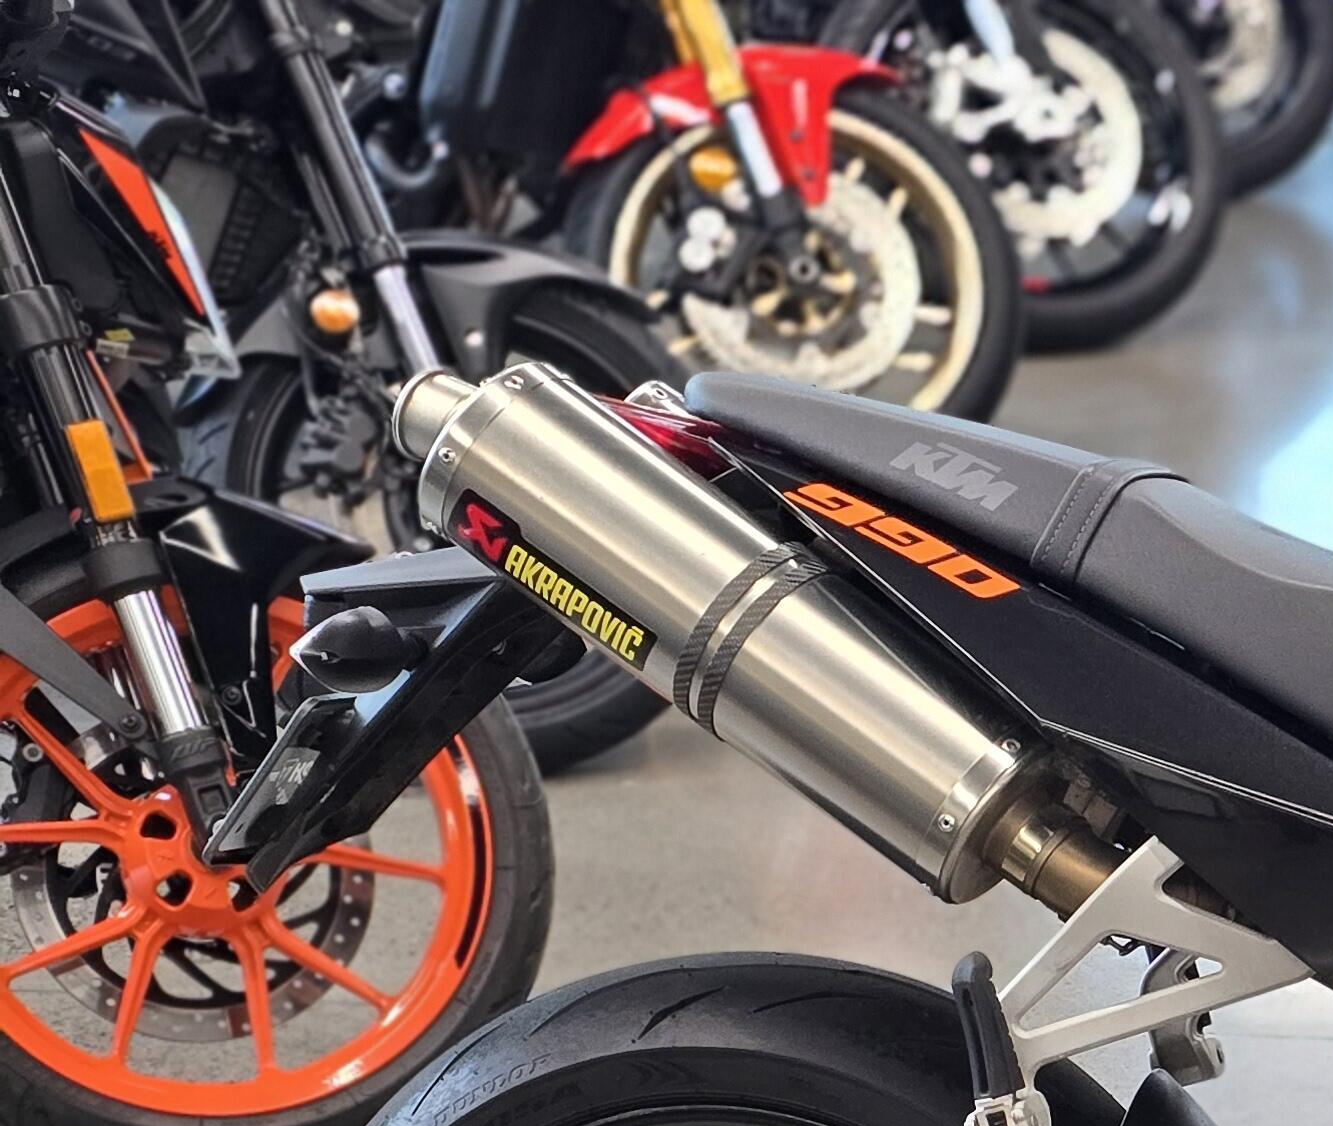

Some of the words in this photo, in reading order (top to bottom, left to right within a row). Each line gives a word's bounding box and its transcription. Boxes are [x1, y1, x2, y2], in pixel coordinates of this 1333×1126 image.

[889, 442, 1018, 511] KTM
[784, 483, 1021, 598] 990
[505, 544, 645, 661] AKRAPOVIČ
